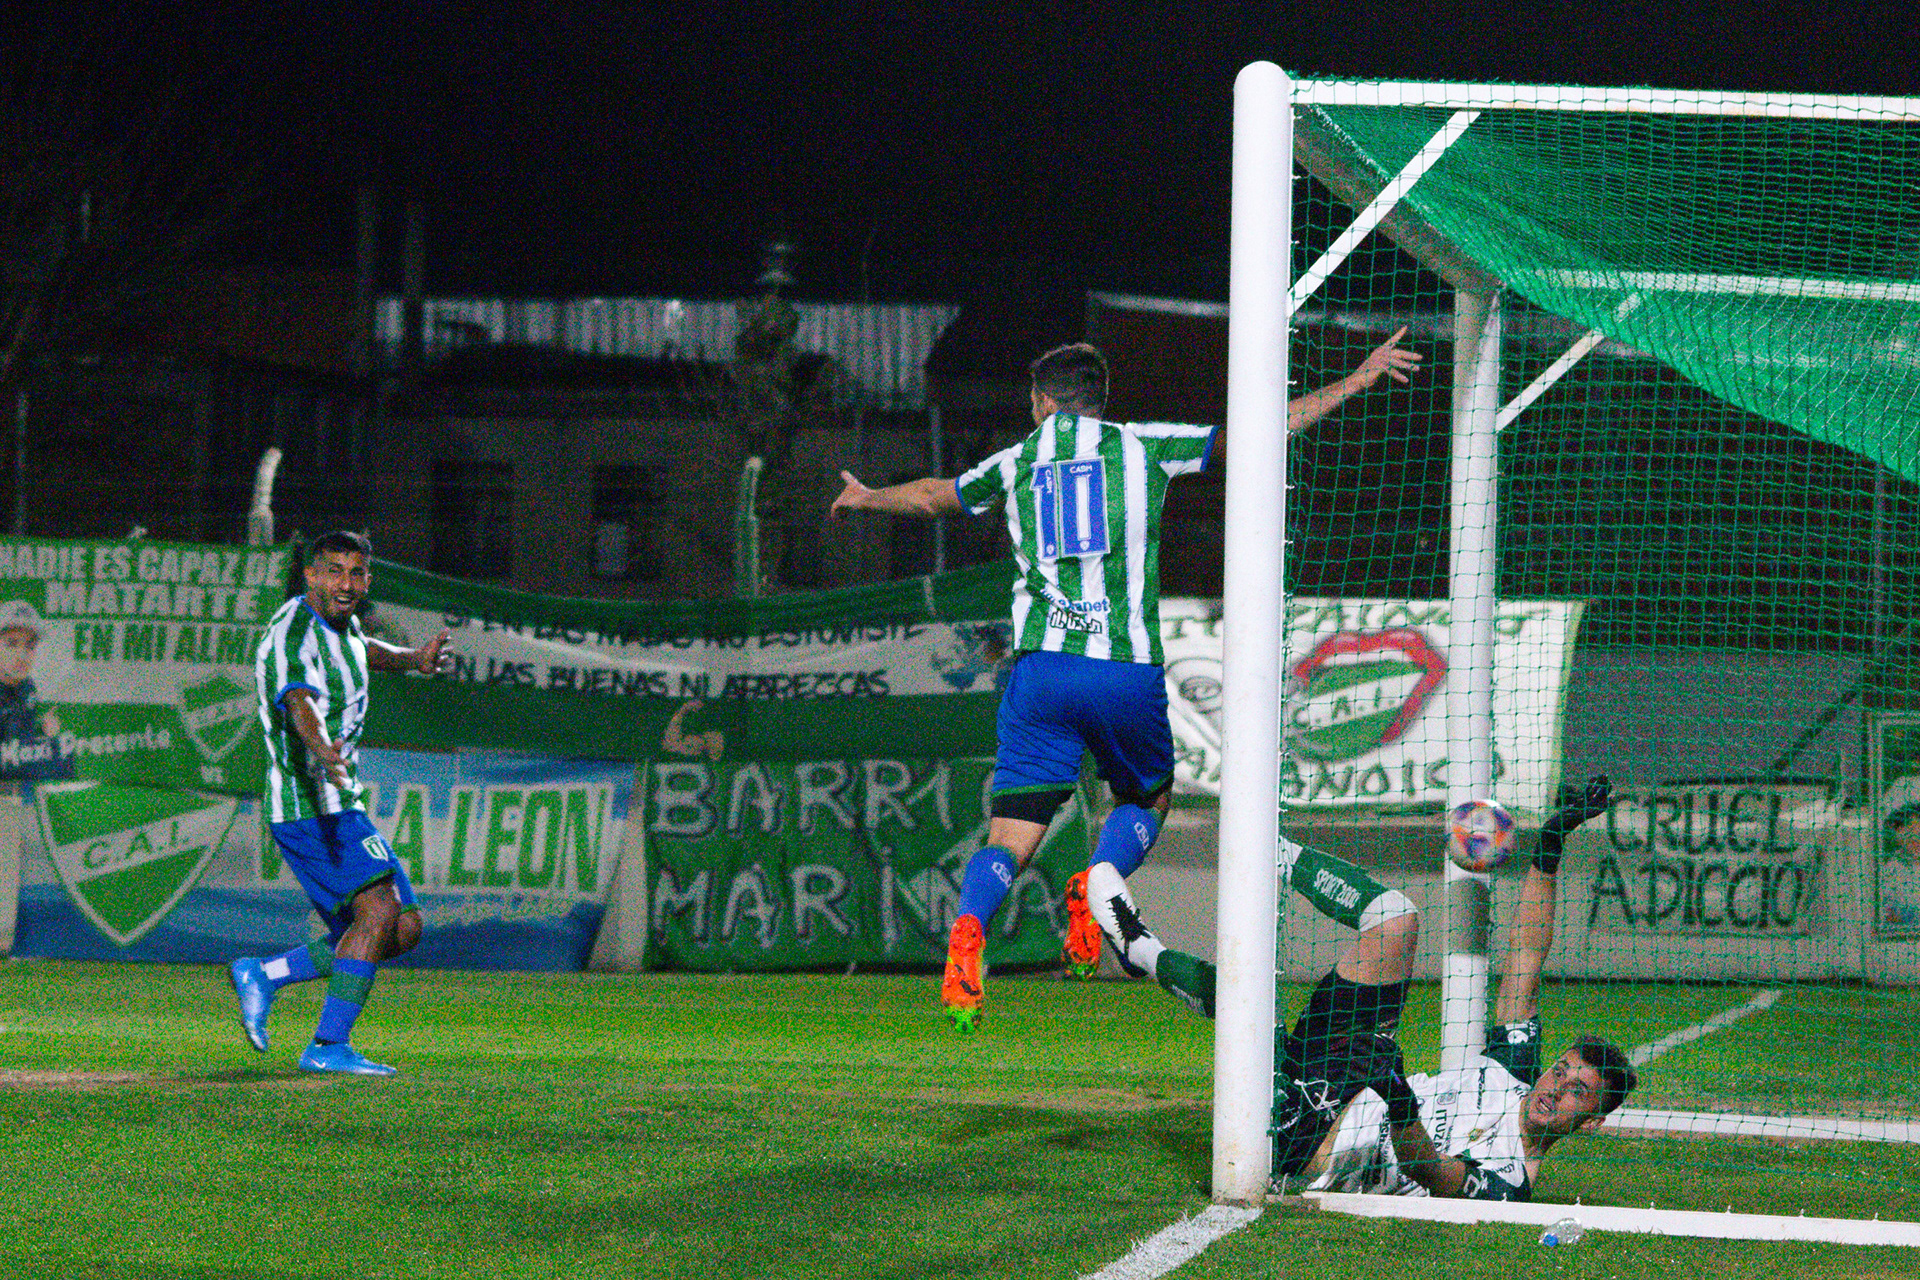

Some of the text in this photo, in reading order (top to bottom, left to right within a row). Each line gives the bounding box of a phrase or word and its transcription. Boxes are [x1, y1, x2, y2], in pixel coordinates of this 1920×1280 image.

[94, 546, 132, 581] ES
[137, 548, 242, 584] CAPAZ
[244, 551, 286, 588] DE
[45, 582, 260, 621] MATARTE
[75, 622, 116, 661] EN
[122, 623, 168, 662] MI
[60, 724, 172, 760] Presente
[650, 761, 995, 836] BARRI
[1606, 787, 1798, 856] CRUEL
[83, 820, 190, 870] C.A.I.
[446, 785, 608, 893] LEON
